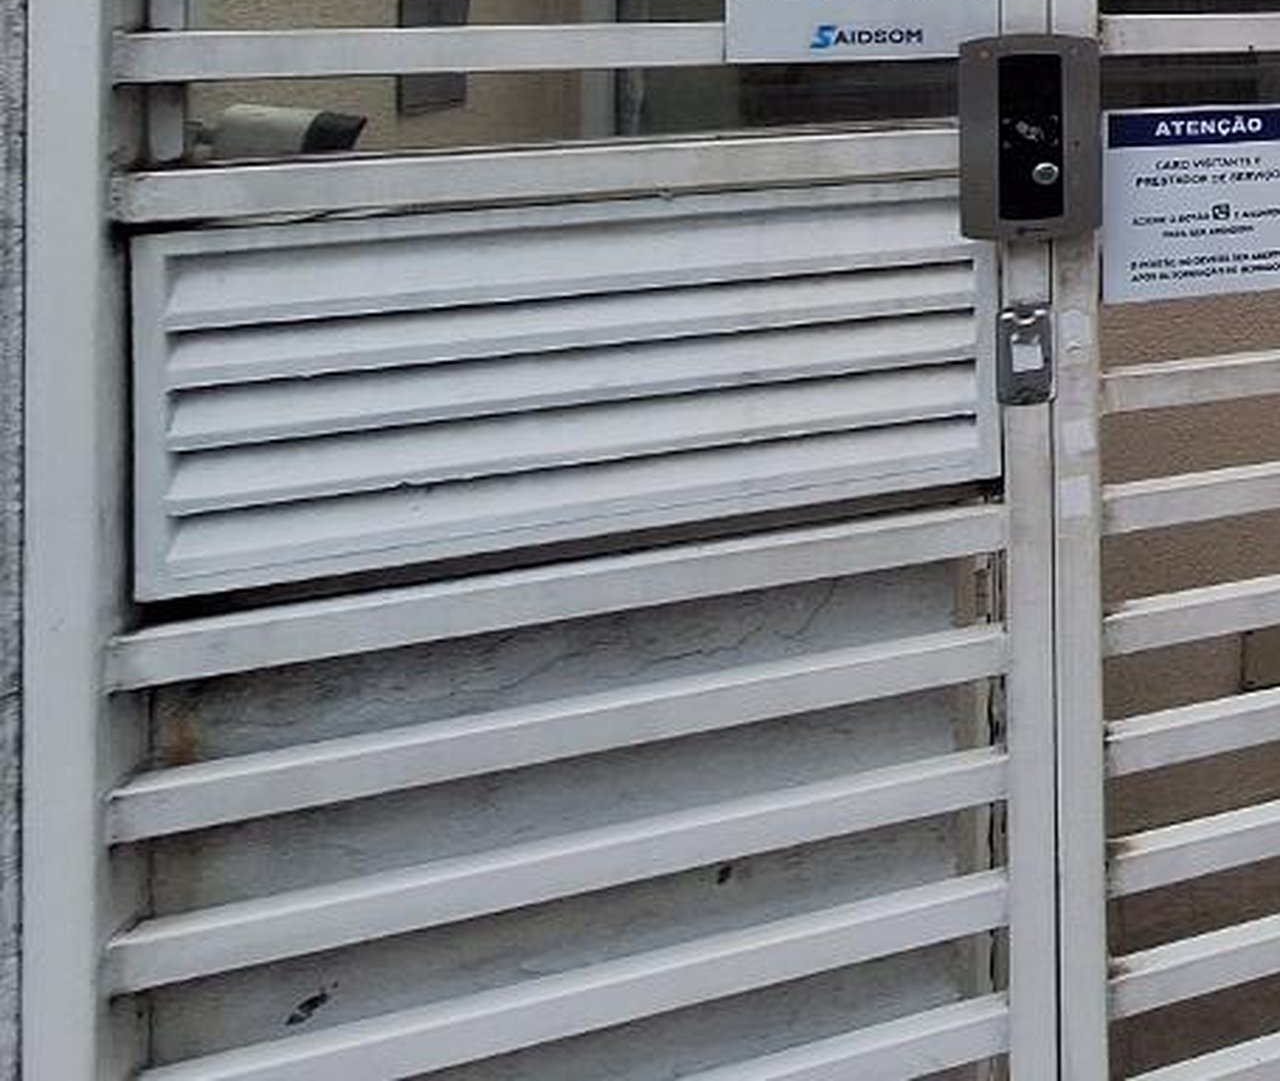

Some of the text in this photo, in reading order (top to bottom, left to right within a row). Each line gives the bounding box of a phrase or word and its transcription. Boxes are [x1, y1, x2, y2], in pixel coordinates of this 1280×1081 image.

[809, 24, 924, 49] SAIDSOM
[1154, 116, 1263, 138] ATENÇÃO
[1155, 160, 1190, 170] CARO
[1135, 174, 1208, 187] PRESTADOR
